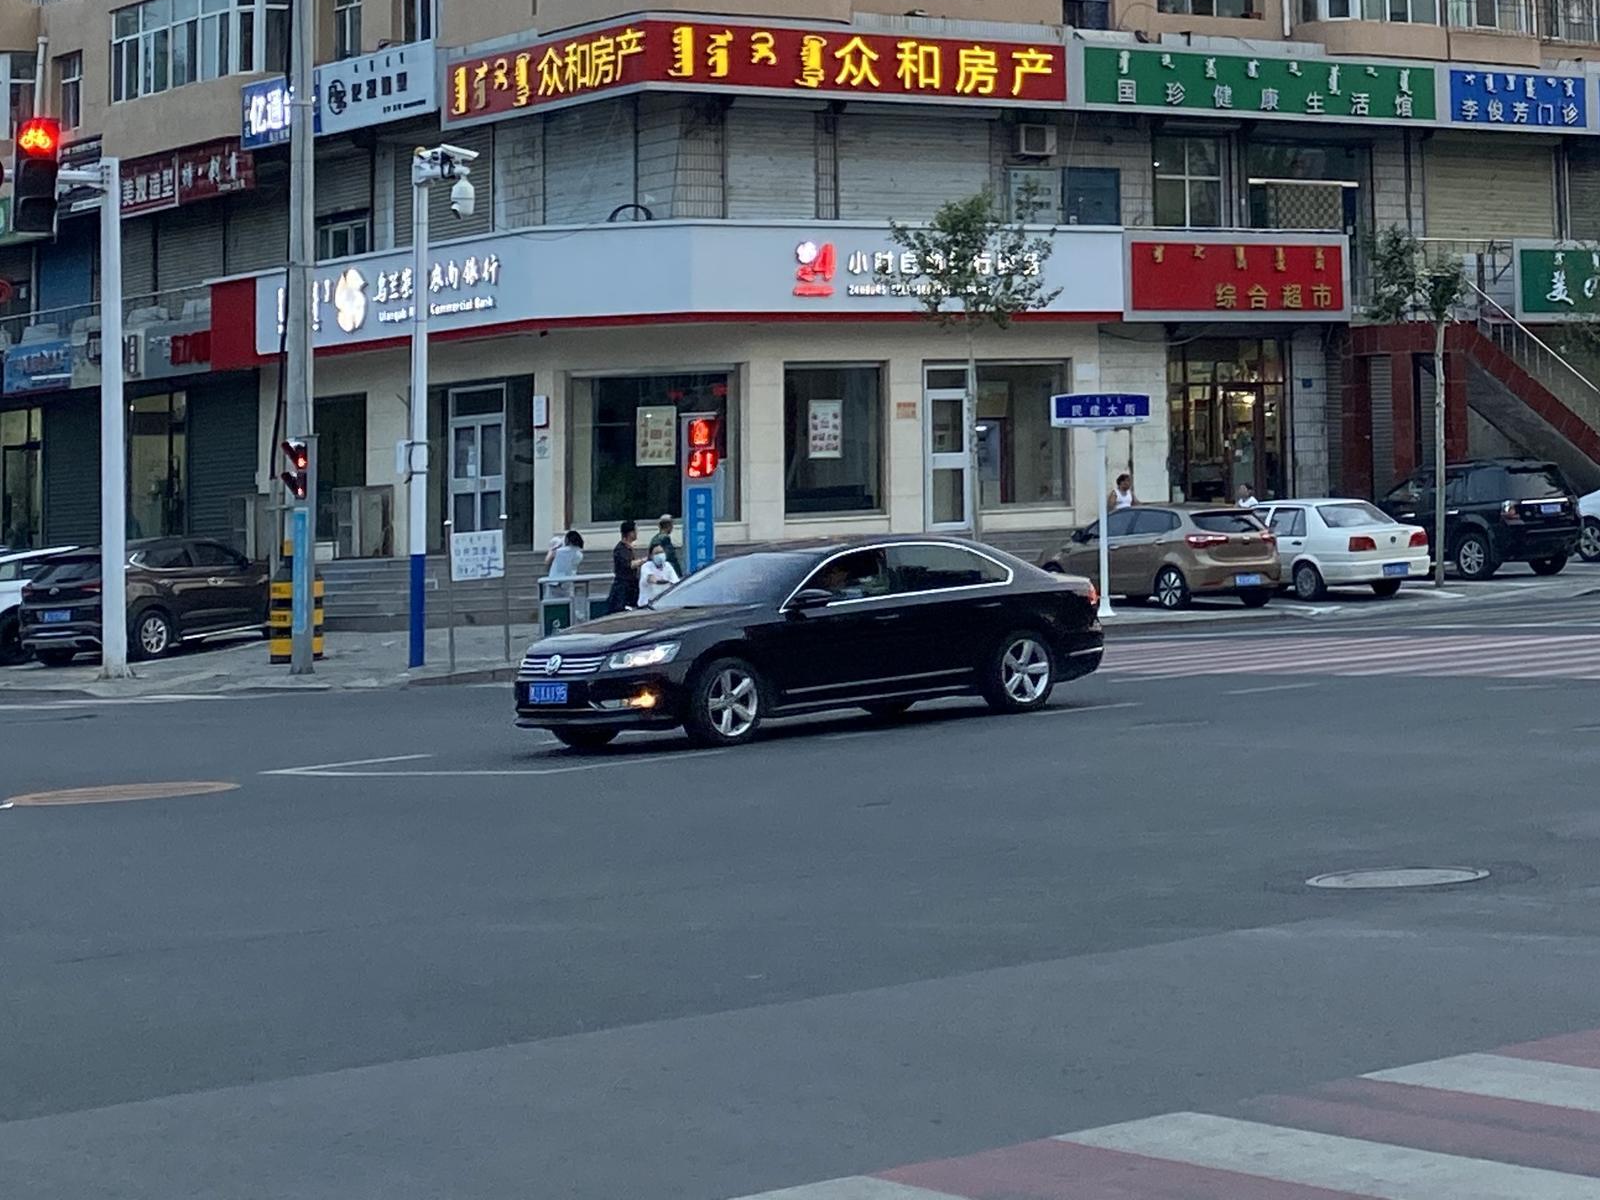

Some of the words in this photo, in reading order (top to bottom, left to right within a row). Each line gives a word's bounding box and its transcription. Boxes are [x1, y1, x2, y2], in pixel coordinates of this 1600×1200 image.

[537, 28, 647, 96] 众和房产
[834, 37, 1053, 96] 众和房产
[1117, 78, 1413, 117] 国珍健康生活馆
[1461, 100, 1579, 126] 李俊芳门诊
[1215, 282, 1332, 309] 综合超市
